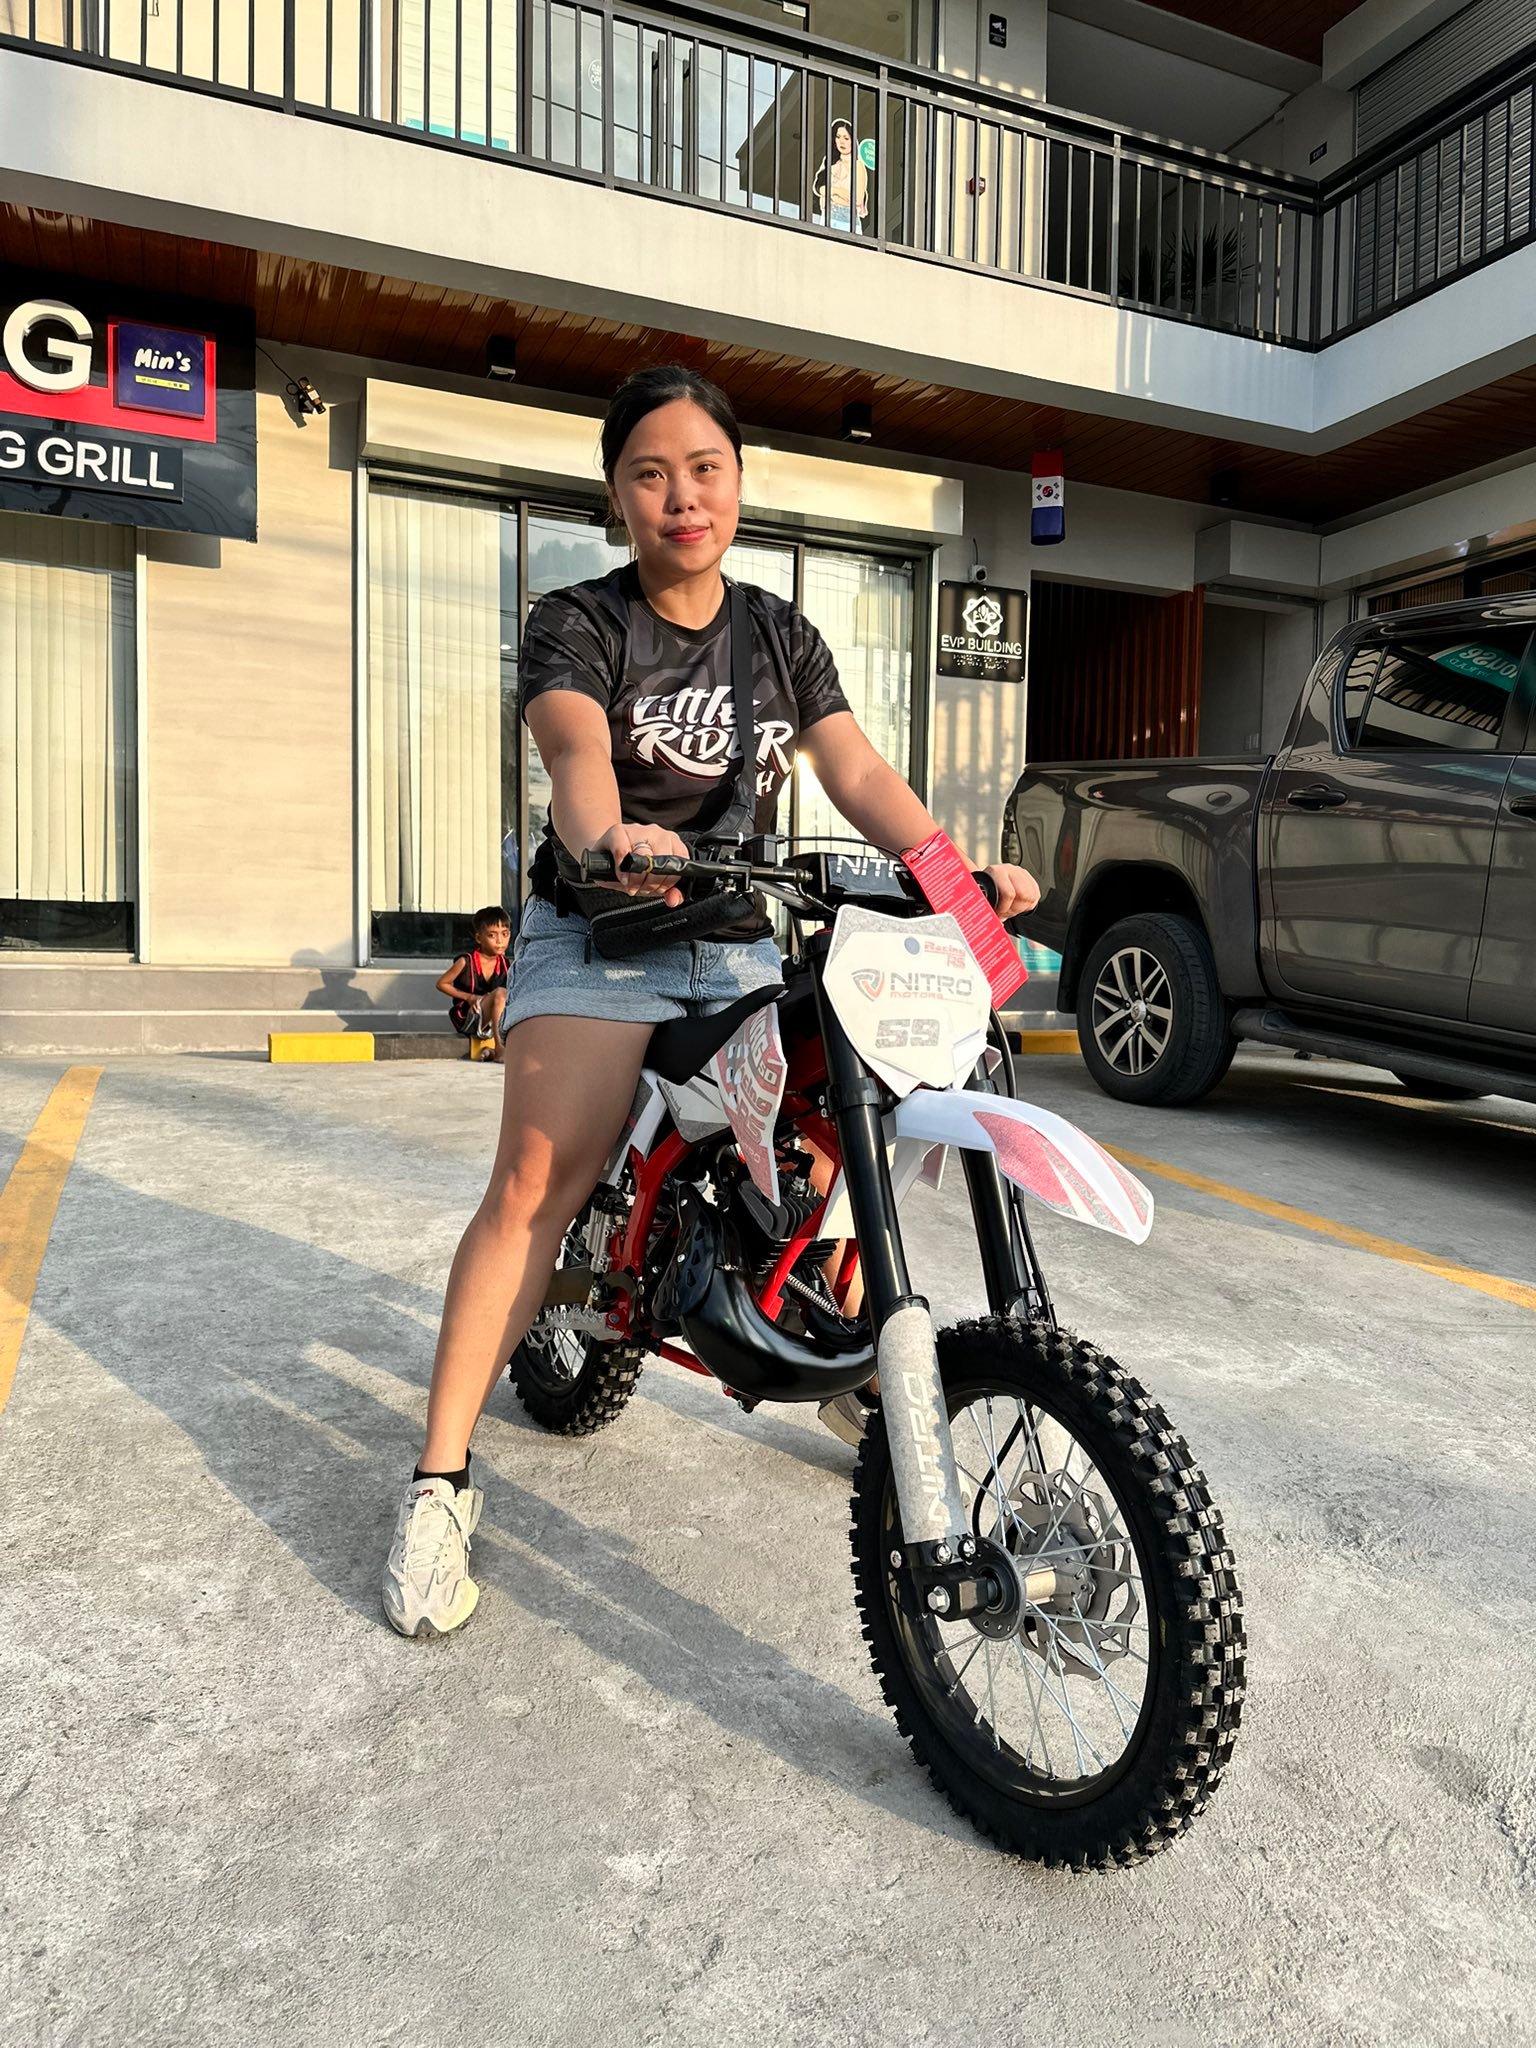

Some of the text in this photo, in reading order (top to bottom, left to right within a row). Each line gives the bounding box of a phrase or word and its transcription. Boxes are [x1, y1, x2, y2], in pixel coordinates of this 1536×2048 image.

[3, 299, 93, 393] G
[134, 348, 191, 372] Min's
[37, 437, 174, 490] GRILL
[941, 634, 1022, 655] EVP BUILDING
[836, 855, 909, 879] NITR
[890, 971, 972, 996] NITRO
[875, 1019, 940, 1048] 59
[902, 1371, 952, 1528] NITRO
